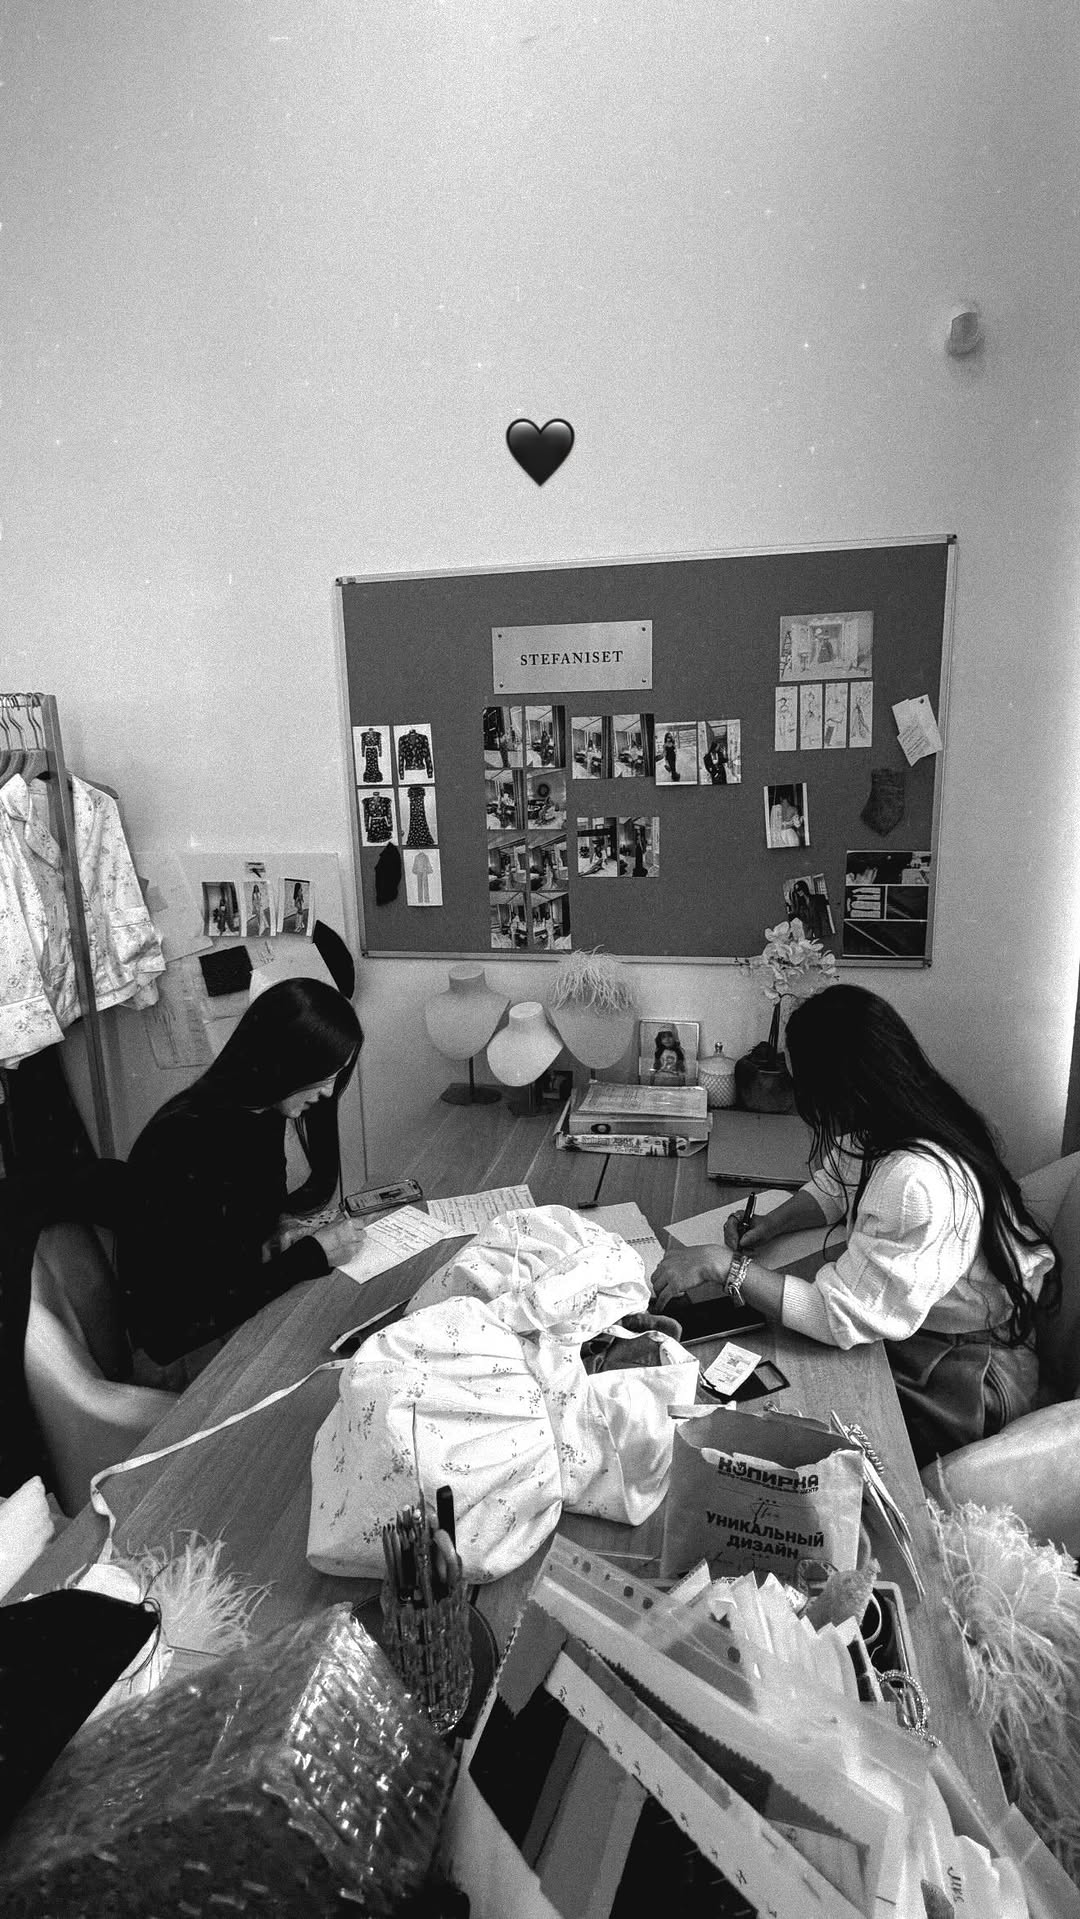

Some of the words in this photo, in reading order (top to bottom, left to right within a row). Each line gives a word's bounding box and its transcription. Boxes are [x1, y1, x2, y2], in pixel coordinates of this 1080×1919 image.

[520, 650, 624, 666] STEFANISET
[706, 1510, 824, 1547] УНИКАЛЬНЫЙ
[726, 1535, 799, 1559] ДИЗАЙН
